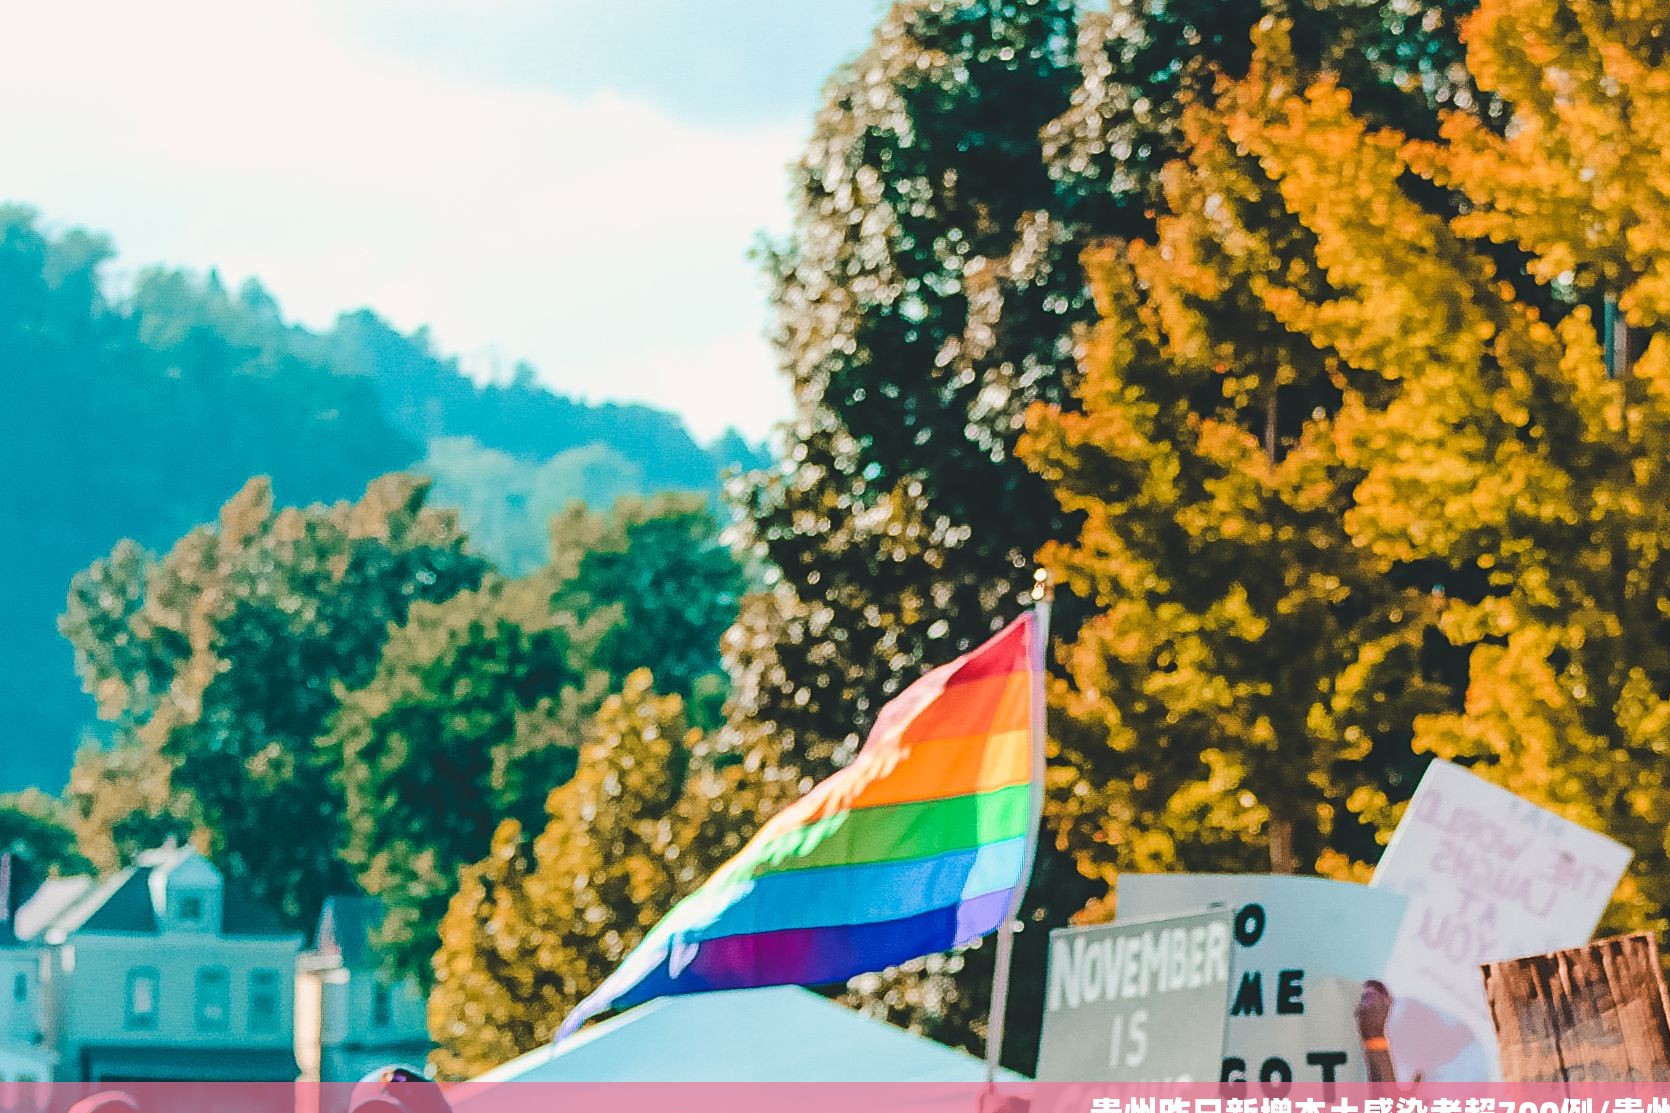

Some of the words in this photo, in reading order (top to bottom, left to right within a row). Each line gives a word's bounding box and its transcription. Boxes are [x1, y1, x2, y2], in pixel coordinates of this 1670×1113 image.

[1049, 920, 1230, 1012] NOVEMBER
[1108, 1013, 1149, 1070] IS
[1219, 1050, 1350, 1104] GOT
